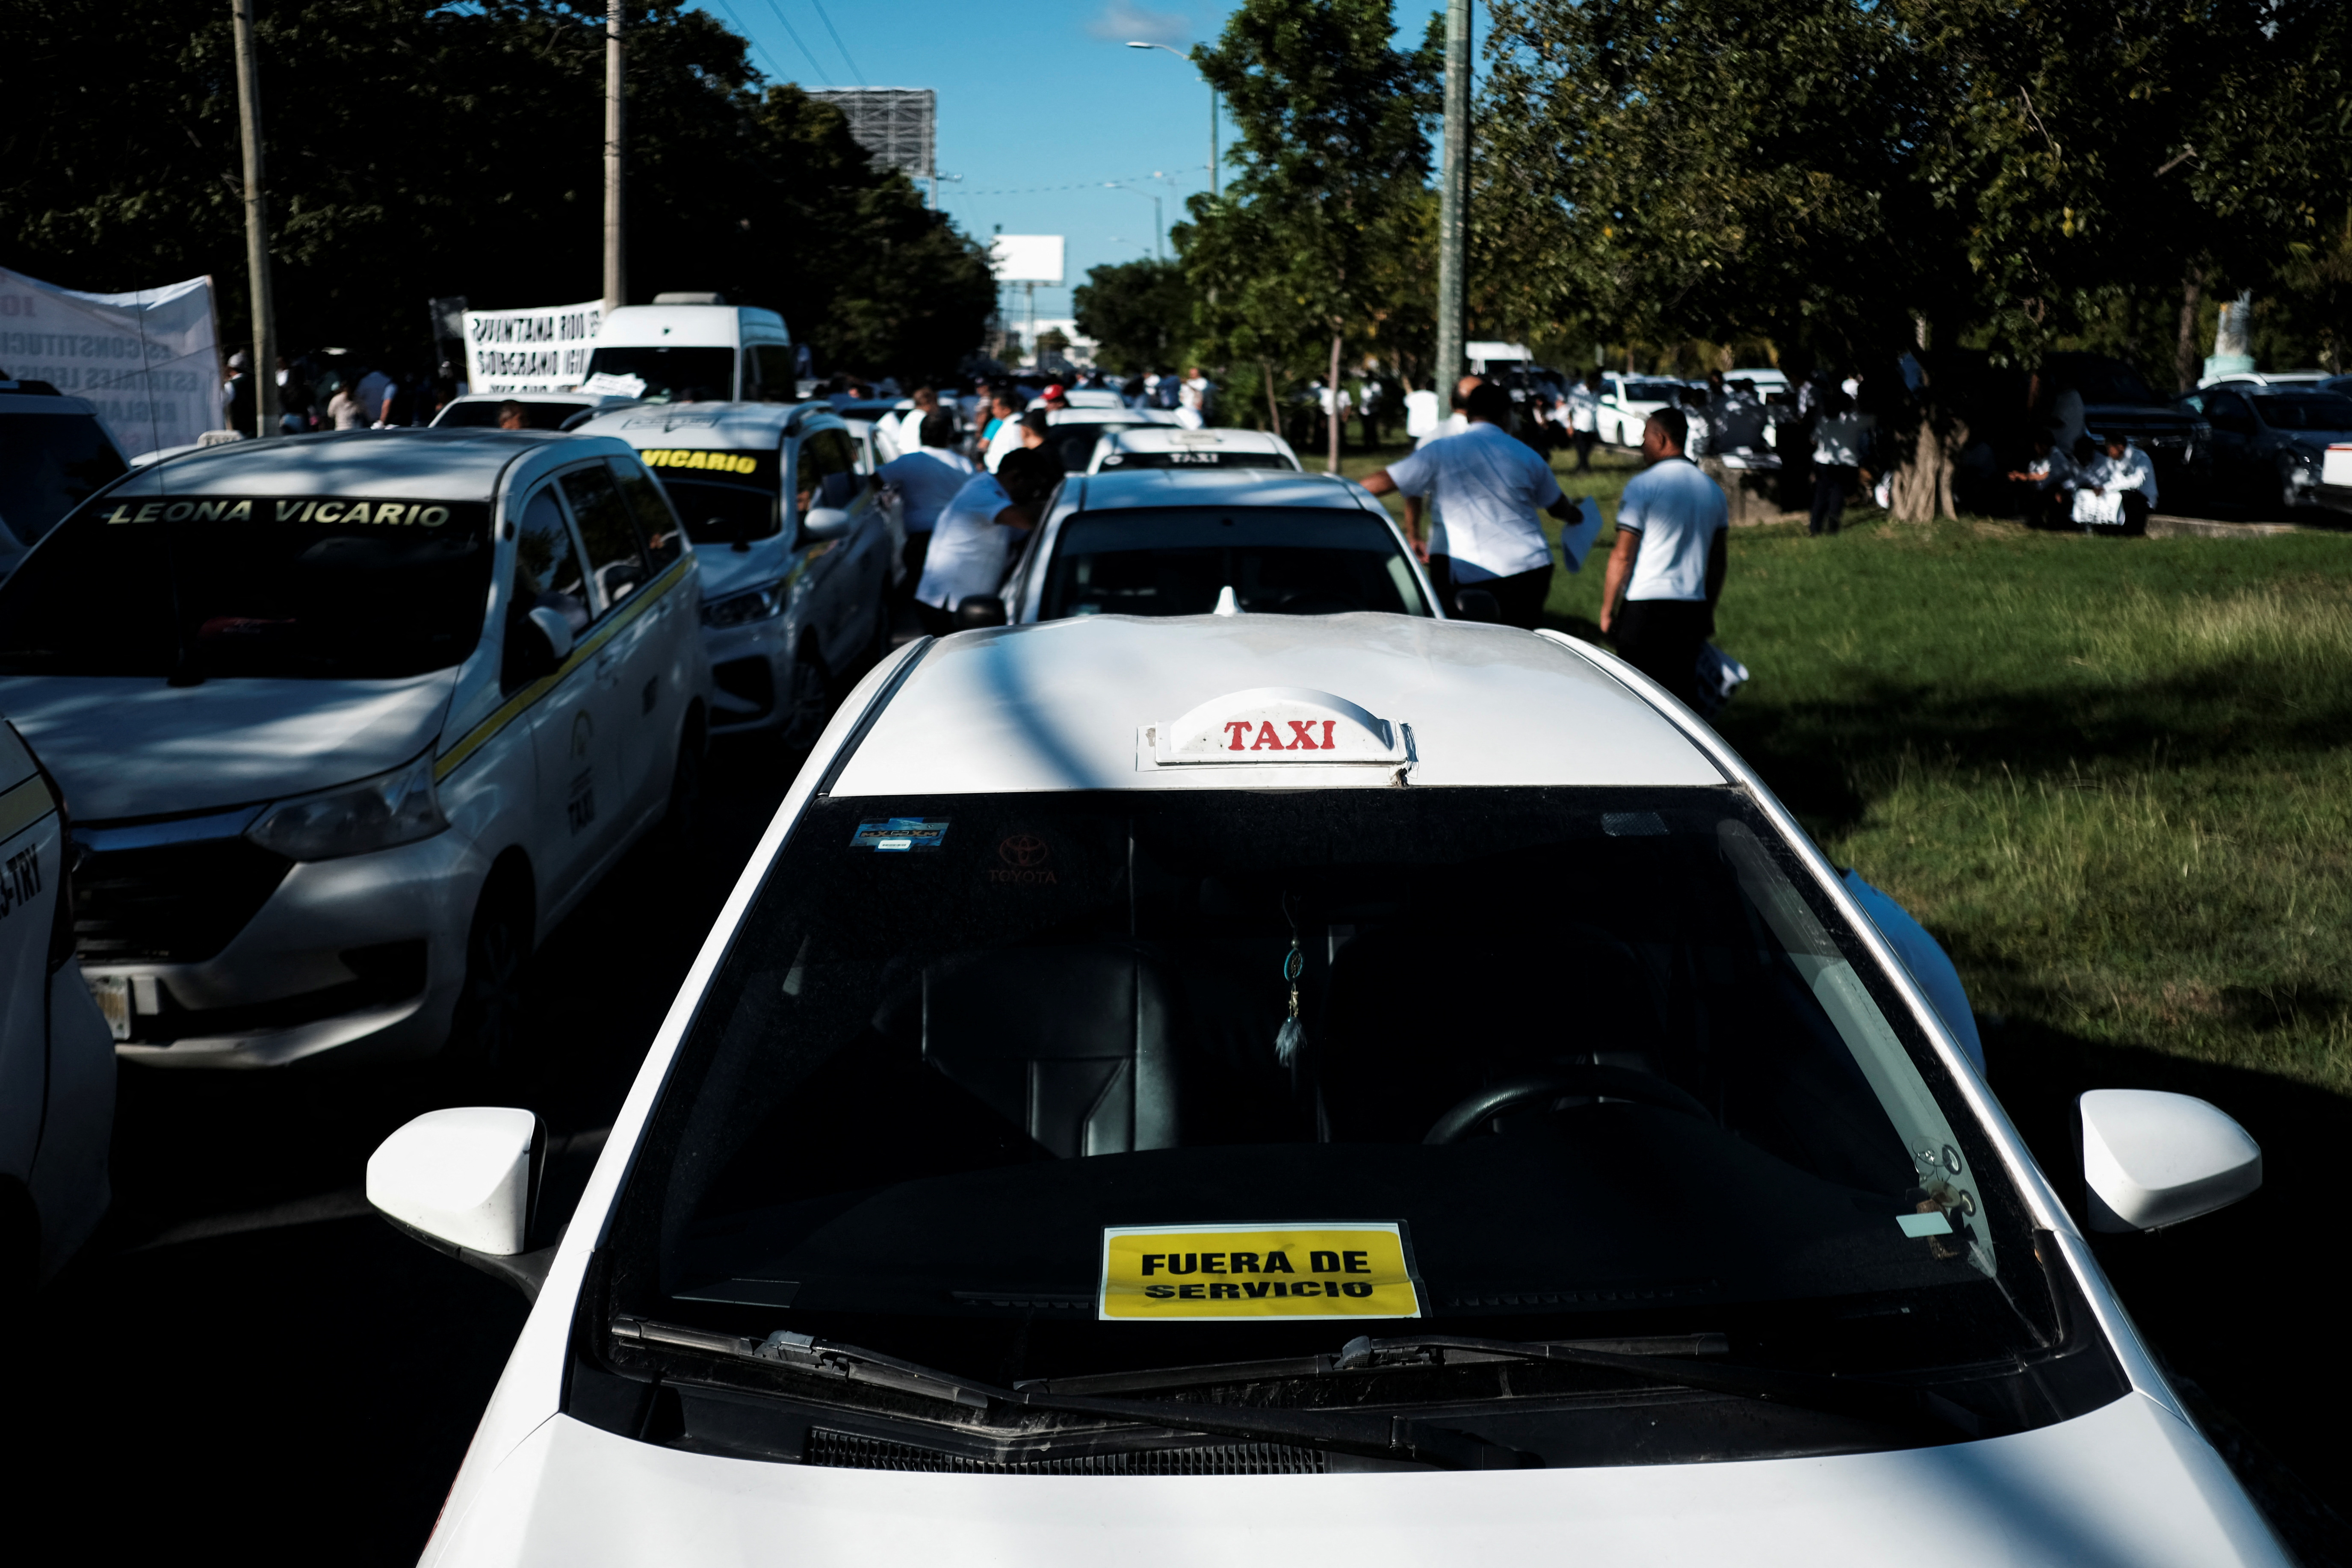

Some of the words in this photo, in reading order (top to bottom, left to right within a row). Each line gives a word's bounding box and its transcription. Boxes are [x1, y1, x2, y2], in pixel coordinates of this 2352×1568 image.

[641, 449, 757, 474] VICARIO
[1170, 453, 1219, 464] TAXI
[107, 500, 253, 525] LEONA
[275, 499, 450, 527] VICARIO
[1224, 721, 1336, 750] TAXI
[989, 870, 1057, 884] TOYOTA
[1141, 1251, 1295, 1276] FUERA
[1310, 1250, 1371, 1273] DE
[1144, 1281, 1373, 1299] SERVICIO
